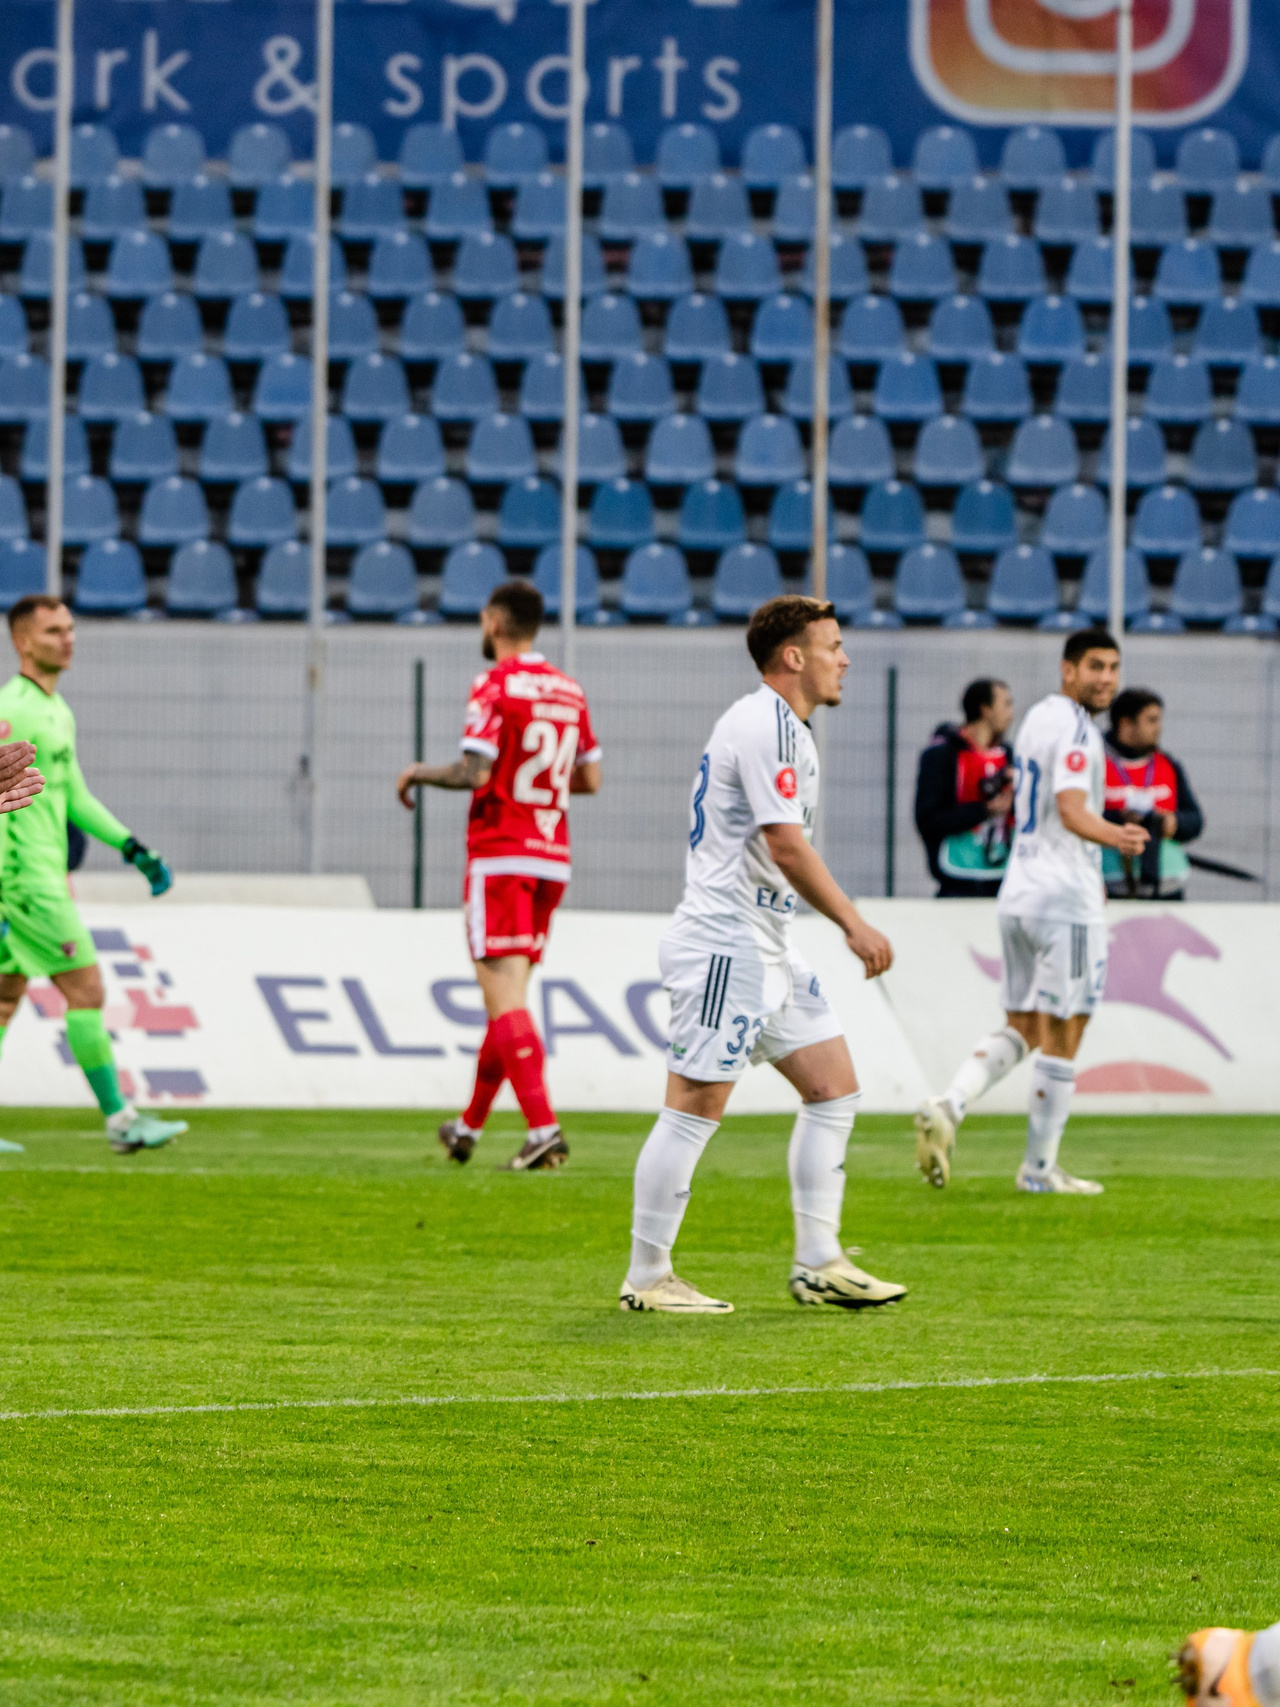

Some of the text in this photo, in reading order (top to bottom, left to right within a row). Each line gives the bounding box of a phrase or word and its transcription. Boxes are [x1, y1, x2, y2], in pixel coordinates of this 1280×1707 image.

[253, 35, 319, 115] &
[384, 37, 742, 132] sports
[512, 719, 580, 811] 24
[756, 886, 797, 914] ELS
[253, 974, 669, 1058] ELSAC
